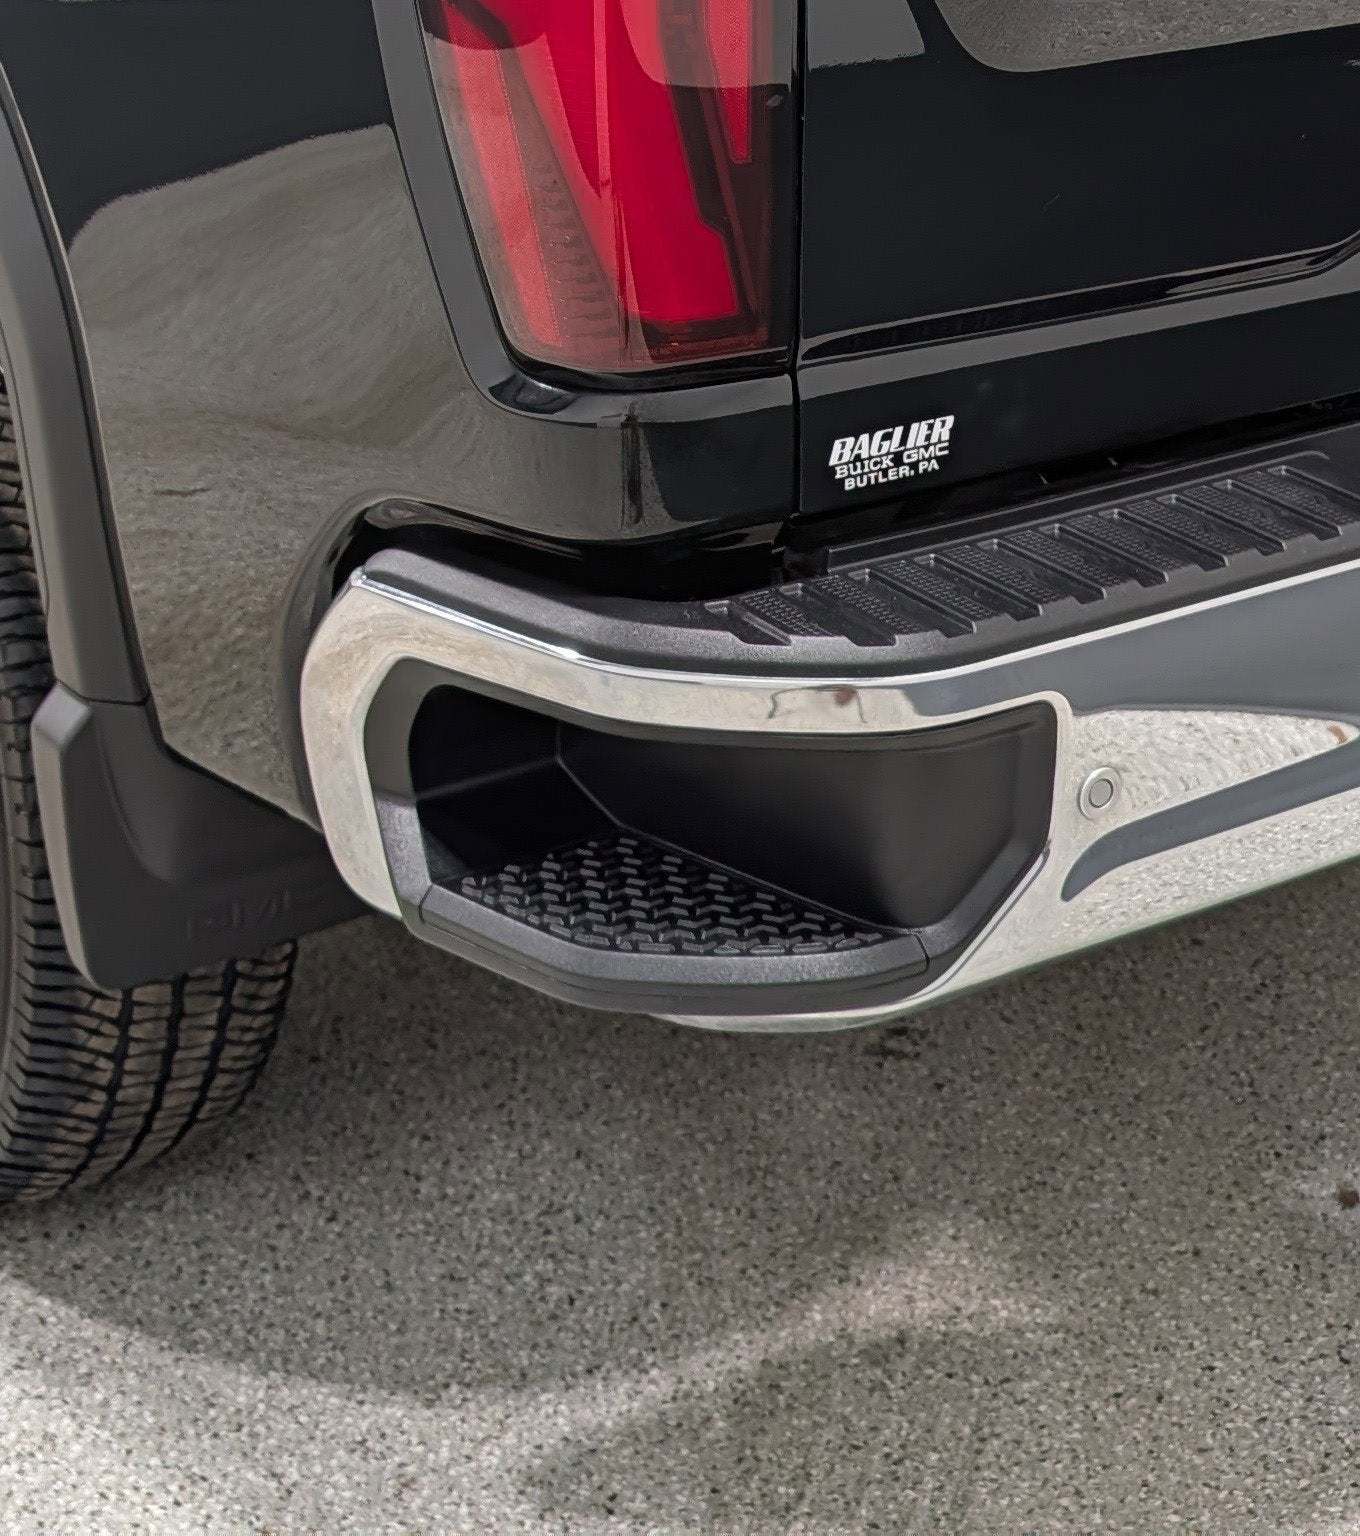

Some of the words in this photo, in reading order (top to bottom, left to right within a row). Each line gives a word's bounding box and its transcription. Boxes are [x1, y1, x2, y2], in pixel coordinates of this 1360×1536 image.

[828, 415, 955, 466] BAGLIER
[834, 453, 895, 480] BUICK
[902, 441, 950, 464] GMC
[918, 460, 940, 474] PA
